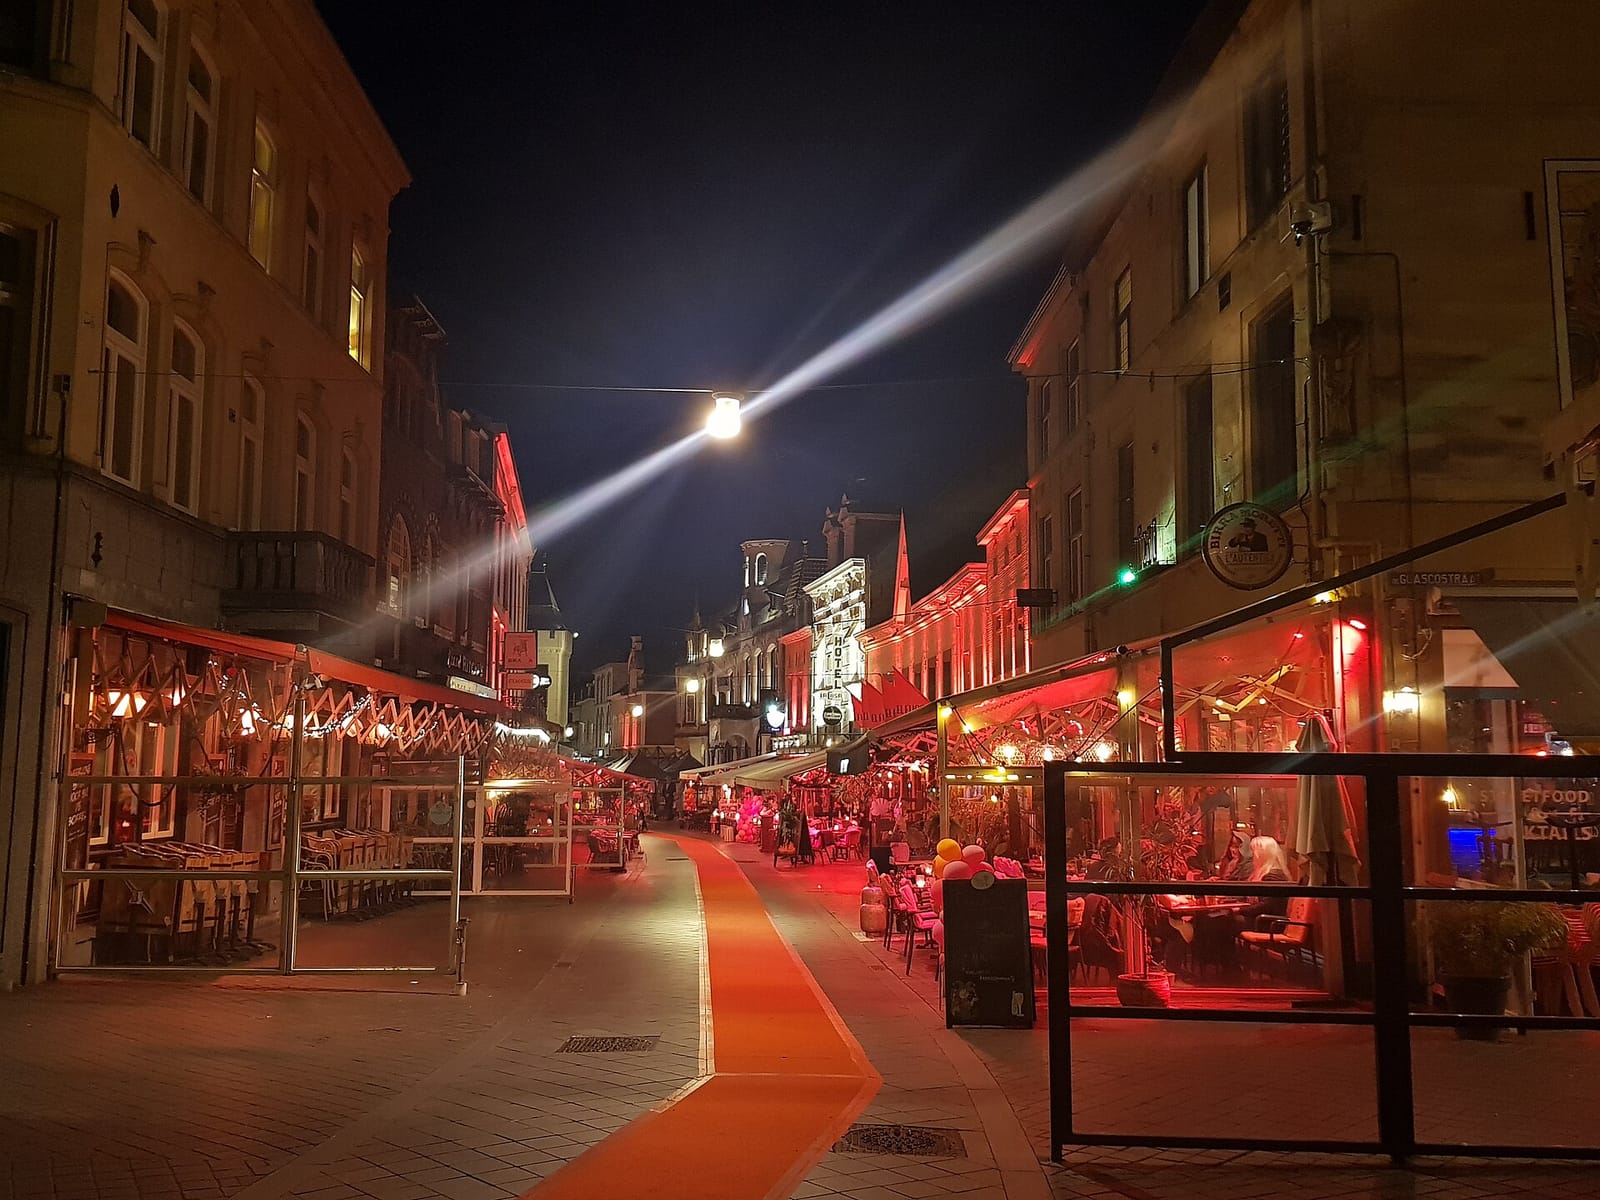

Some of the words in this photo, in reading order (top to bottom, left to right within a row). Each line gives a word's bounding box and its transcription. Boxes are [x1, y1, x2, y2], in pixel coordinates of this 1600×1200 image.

[834, 636, 842, 690] HOTEL
[1480, 789, 1591, 804] STETFOOD
[1523, 825, 1593, 842] KTAILS
